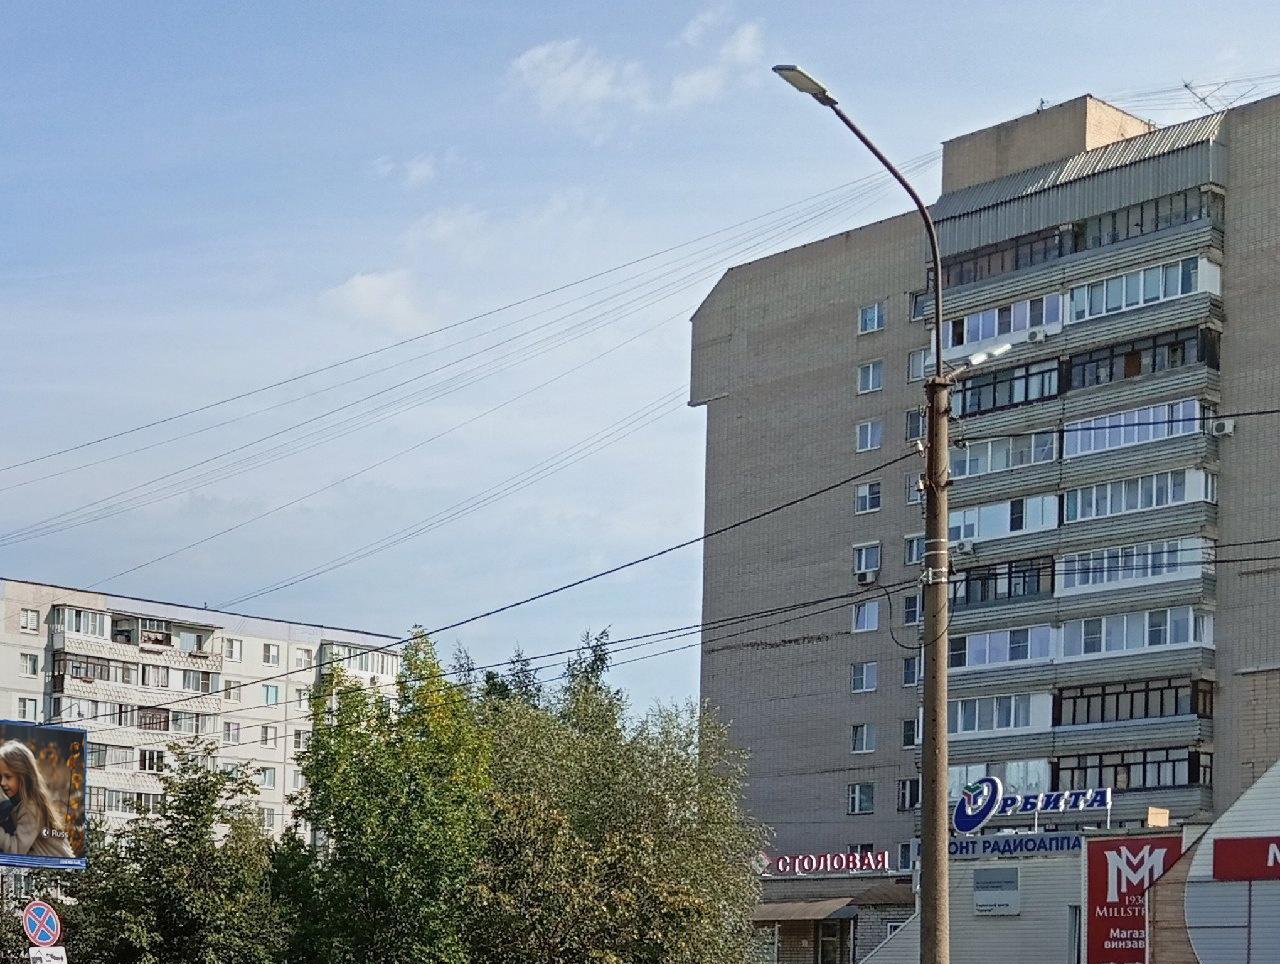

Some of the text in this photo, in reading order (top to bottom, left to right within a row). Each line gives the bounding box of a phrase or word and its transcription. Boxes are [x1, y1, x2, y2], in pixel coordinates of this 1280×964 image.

[51, 829, 69, 838] Russ
[982, 836, 1082, 855] РАДИОАППА
[776, 850, 889, 873] СТОЛОВАЯ
